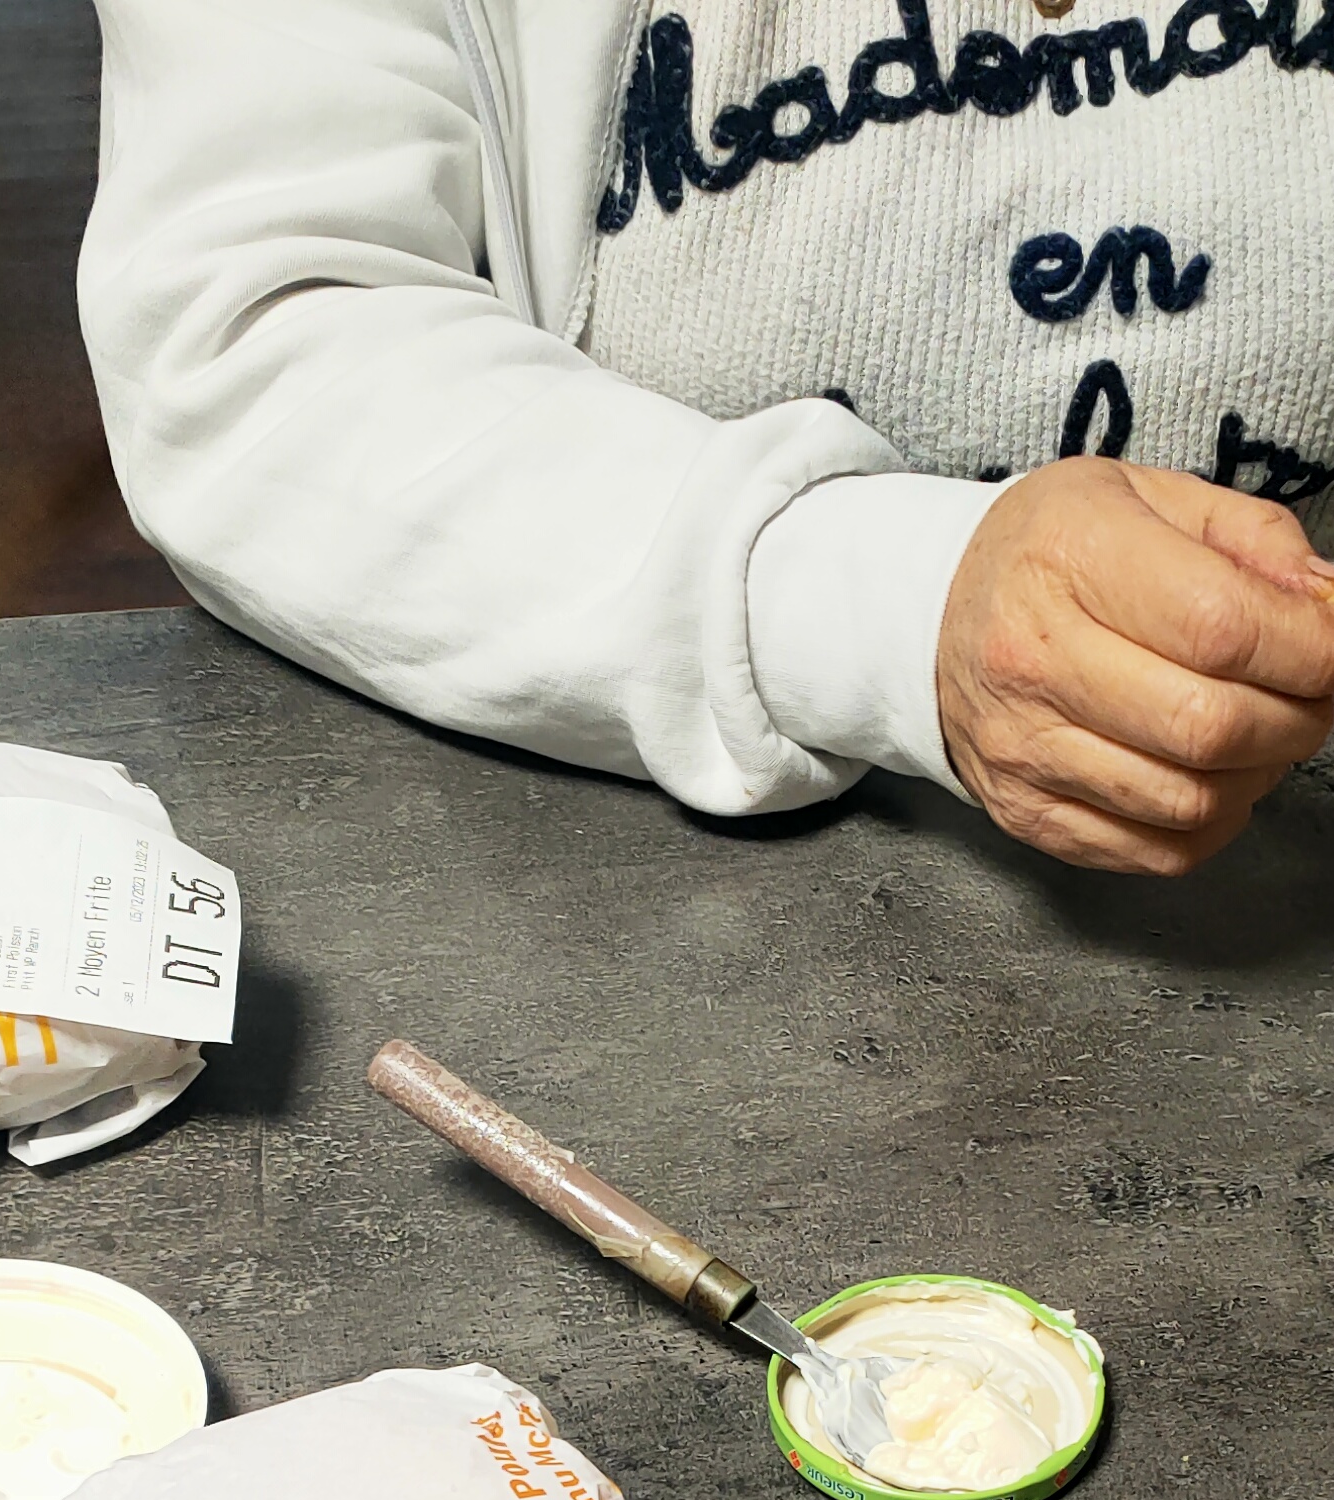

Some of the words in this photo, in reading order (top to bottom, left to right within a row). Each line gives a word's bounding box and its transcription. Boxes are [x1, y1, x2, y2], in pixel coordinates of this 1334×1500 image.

[1010, 225, 1212, 322] en
[84, 875, 111, 922] Frite
[168, 872, 225, 919] 56
[77, 930, 108, 977] Moyen
[162, 935, 222, 988] DT
[75, 985, 100, 997] 2
